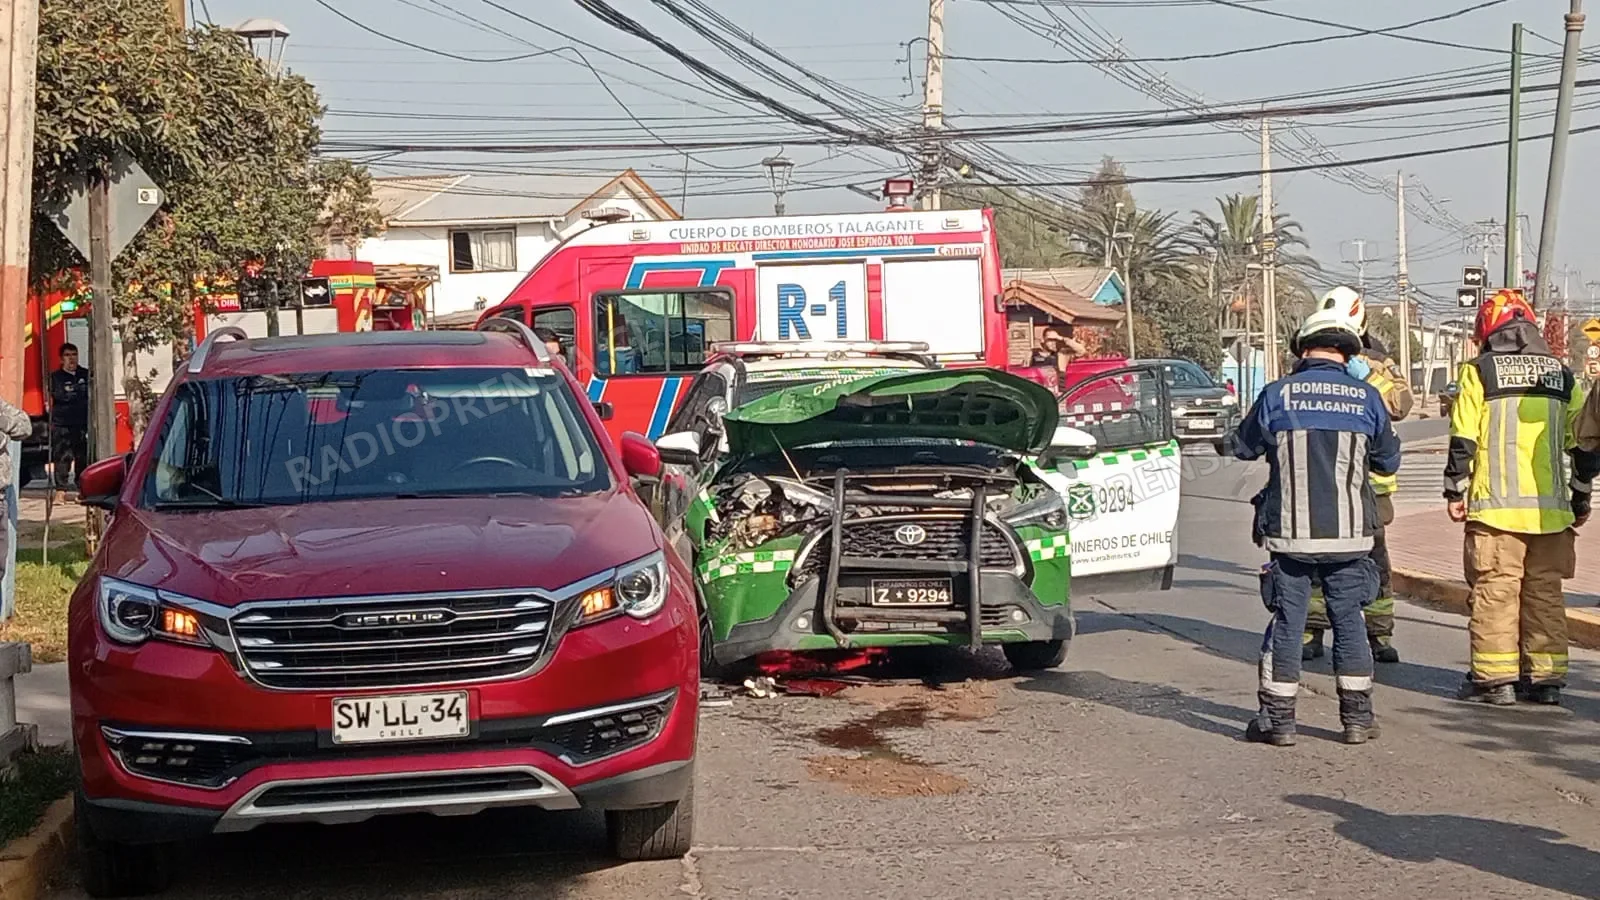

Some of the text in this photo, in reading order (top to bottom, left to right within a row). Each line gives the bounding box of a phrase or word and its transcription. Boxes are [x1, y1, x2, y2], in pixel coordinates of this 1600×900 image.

[669, 219, 925, 240] CUERPO DE BOMBEROS TALAGANTE
[680, 242, 711, 254] UNIDAD
[711, 242, 721, 253] DE
[722, 240, 753, 252] RESCATE
[755, 239, 790, 251] DIRECTOR
[791, 237, 836, 250] HONORARIO
[856, 235, 893, 247] ESPINOZA
[893, 235, 914, 246] TORO
[777, 280, 848, 340] R-1
[1495, 356, 1562, 368] BOMBEROS
[1527, 365, 1535, 376] 2
[1291, 382, 1367, 399] BOMBEROS
[1499, 376, 1562, 391] TALAGNTE
[1280, 383, 1291, 411] 1
[1291, 400, 1365, 415] TALAGANTE
[1099, 485, 1135, 514] 9294
[1121, 534, 1137, 548] DE
[1139, 530, 1172, 546] CHILE
[876, 587, 949, 603] Z 9294
[346, 612, 444, 625] JETOUR
[379, 728, 424, 738] CHILE
